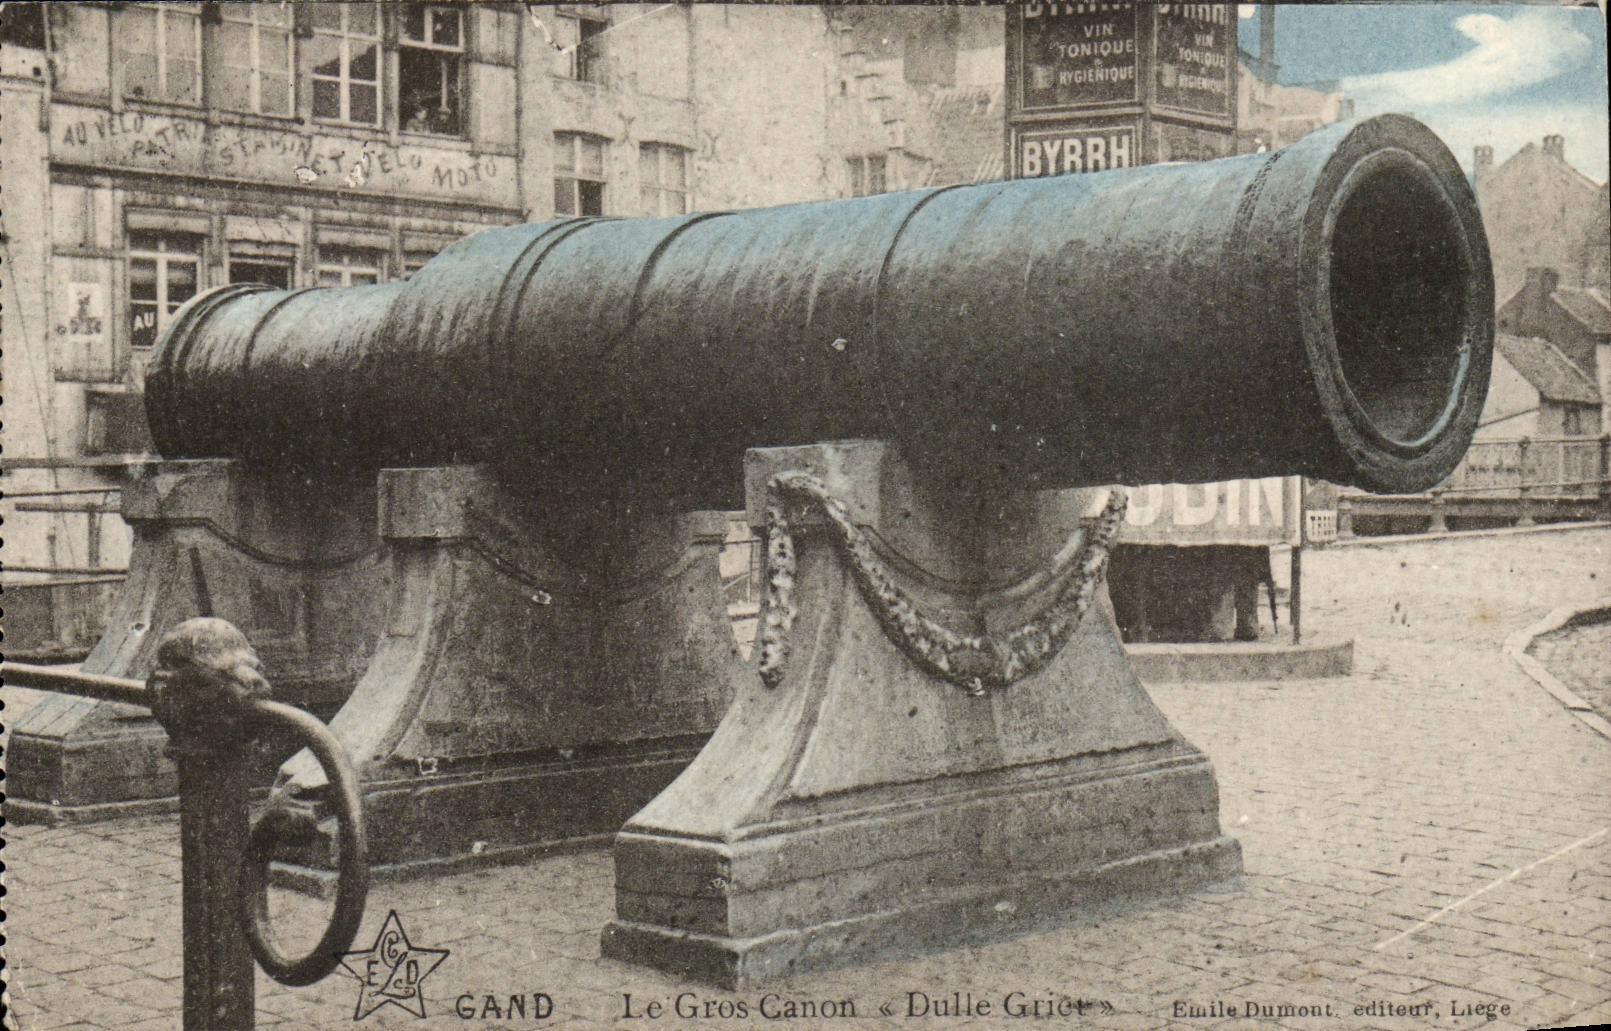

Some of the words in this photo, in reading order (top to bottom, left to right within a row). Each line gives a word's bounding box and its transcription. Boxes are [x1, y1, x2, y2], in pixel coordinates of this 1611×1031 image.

[1084, 23, 1113, 38] VIN
[1059, 39, 1134, 58] TONIQUE
[1179, 47, 1226, 68] TONIQUE
[1023, 135, 1130, 177] BYRRH
[432, 161, 497, 189] MOTO
[134, 312, 154, 331] AU
